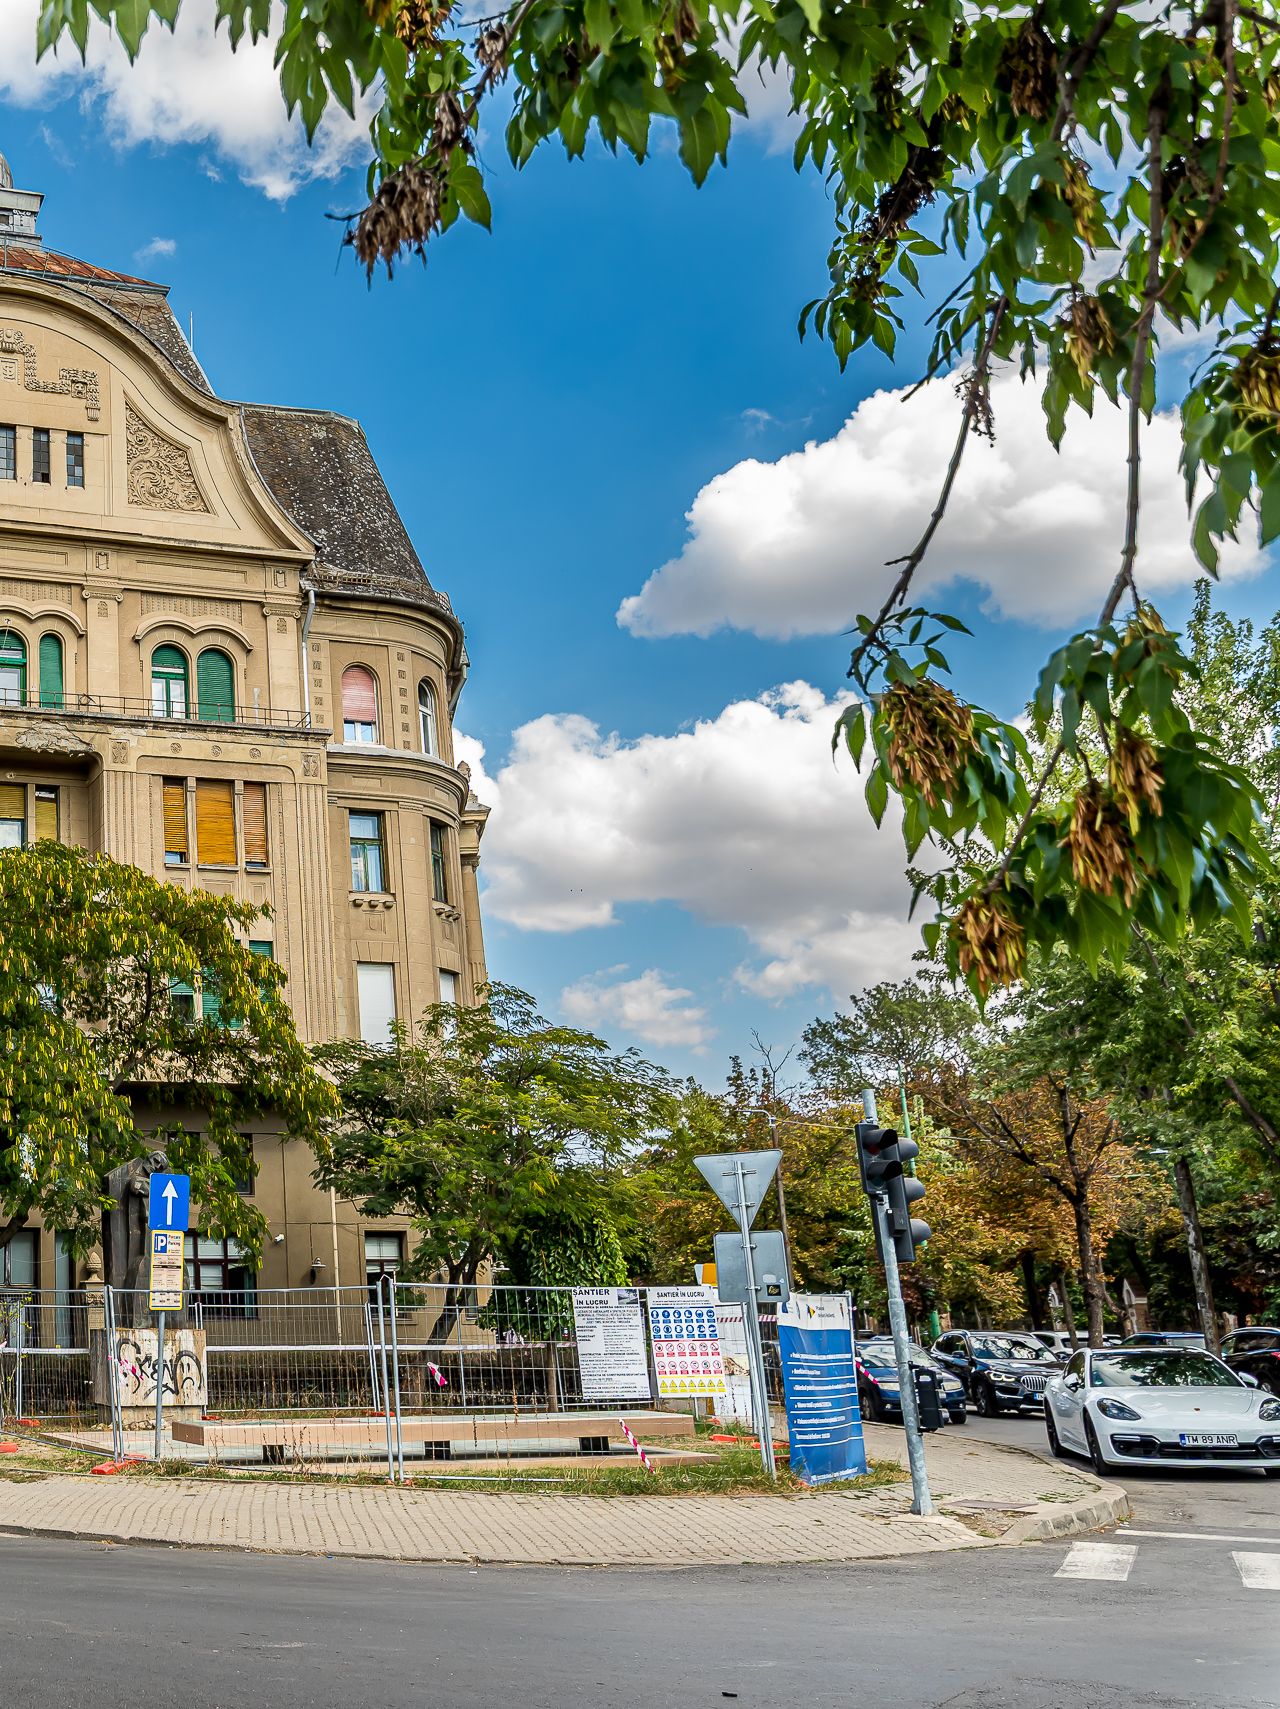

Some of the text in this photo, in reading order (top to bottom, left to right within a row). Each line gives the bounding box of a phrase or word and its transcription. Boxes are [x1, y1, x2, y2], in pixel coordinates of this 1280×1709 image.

[1186, 1435, 1236, 1444] TM 89 ANR
